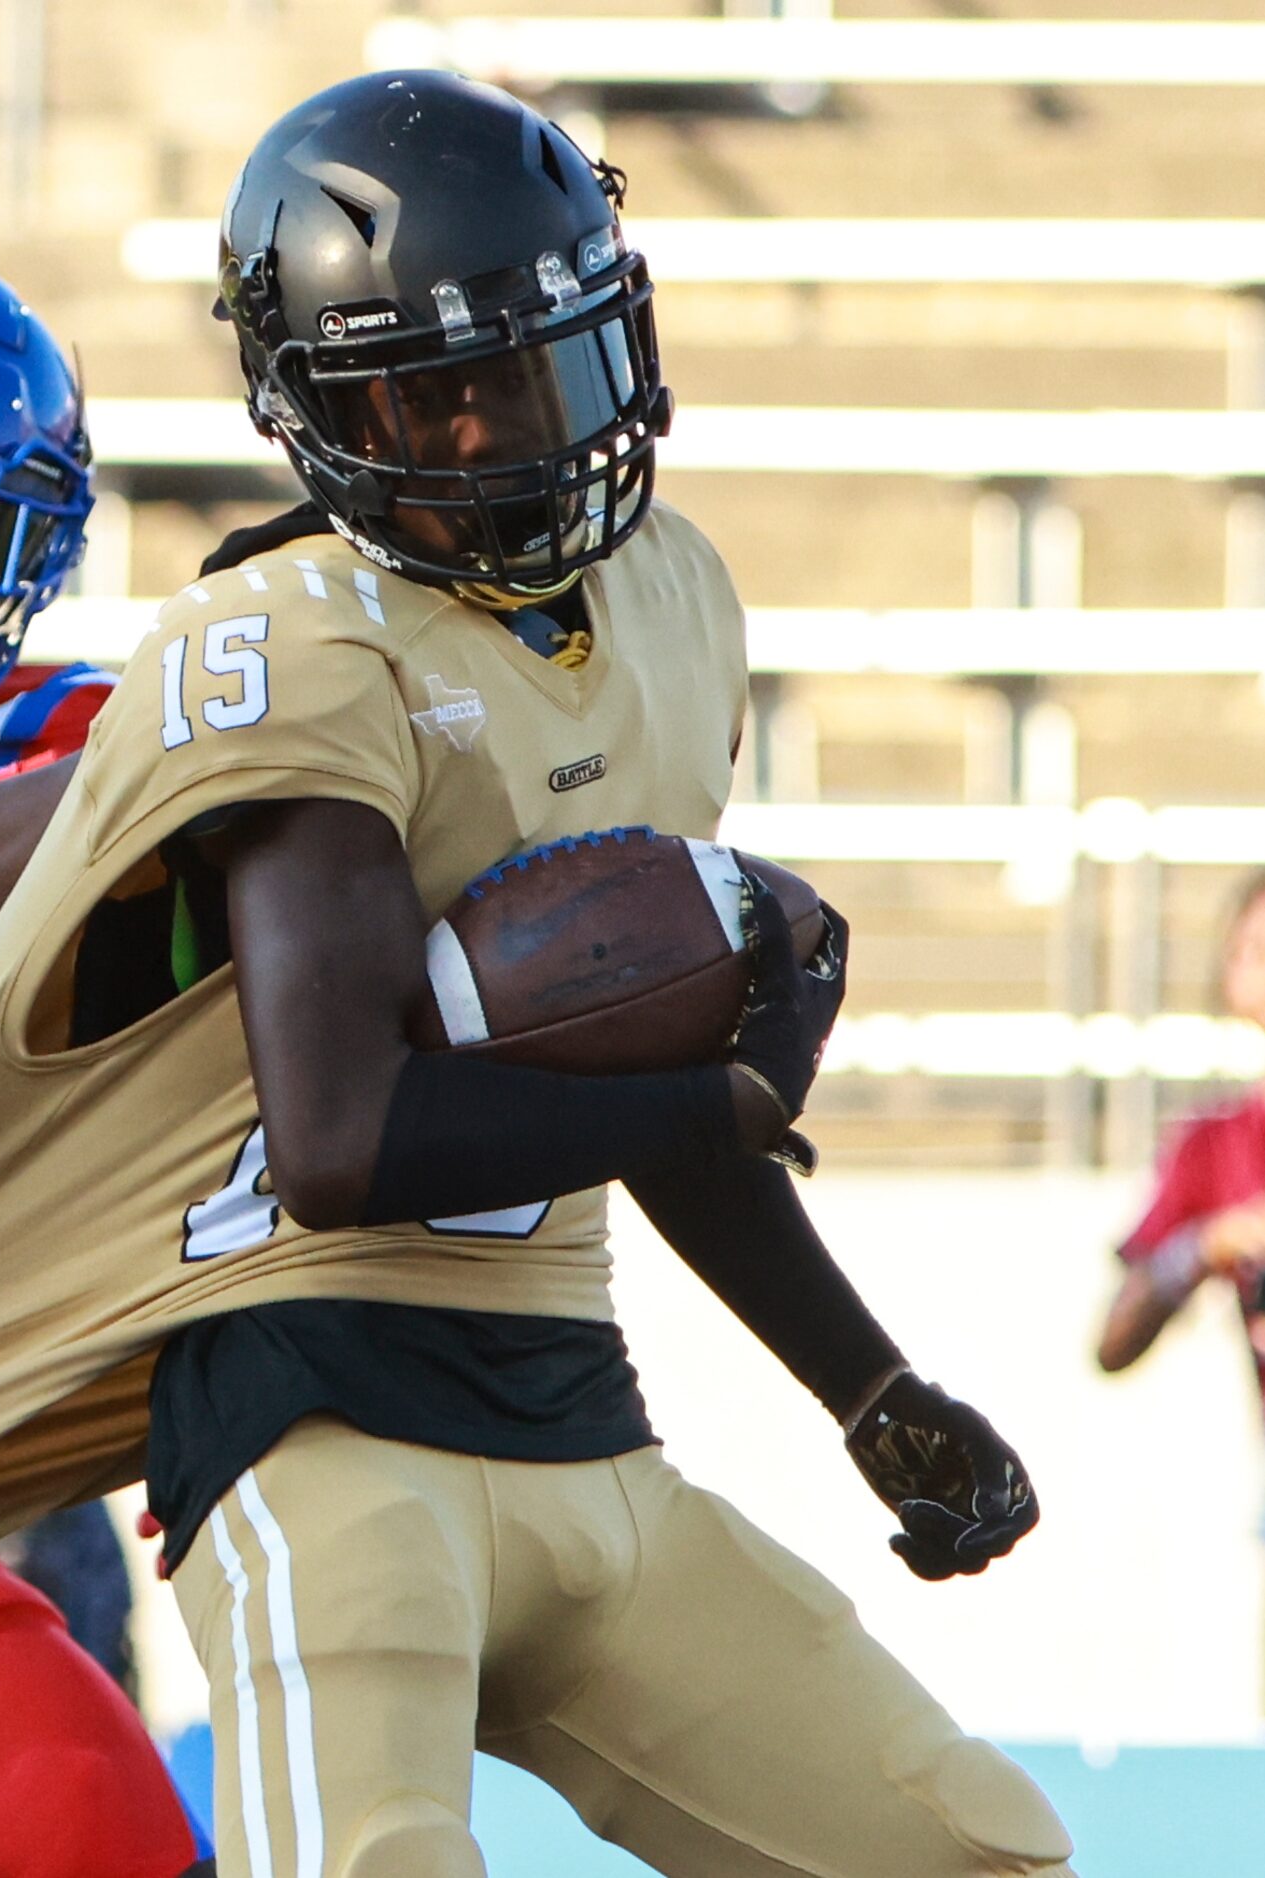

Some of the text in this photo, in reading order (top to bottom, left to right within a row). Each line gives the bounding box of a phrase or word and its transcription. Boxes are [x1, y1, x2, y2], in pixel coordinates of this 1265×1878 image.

[346, 311, 397, 330] SPORTS
[160, 613, 269, 752] 15
[436, 699, 485, 723] MECCA
[557, 759, 603, 786] BATTLE
